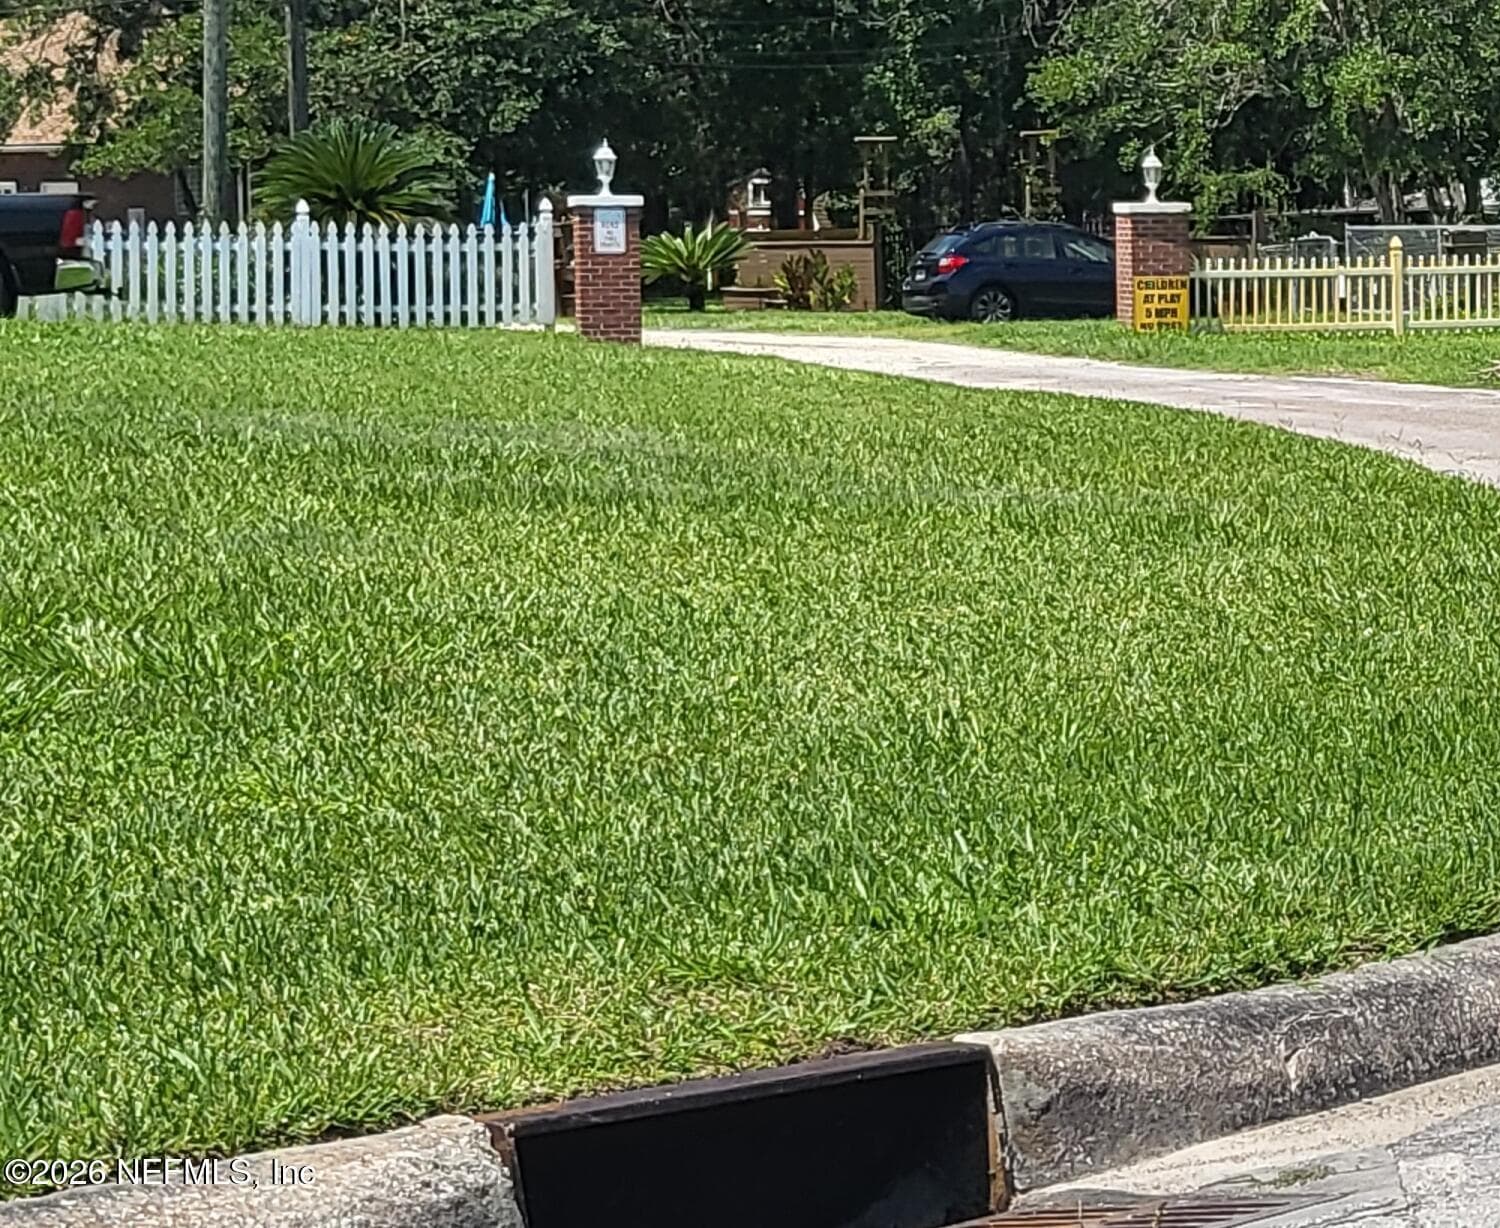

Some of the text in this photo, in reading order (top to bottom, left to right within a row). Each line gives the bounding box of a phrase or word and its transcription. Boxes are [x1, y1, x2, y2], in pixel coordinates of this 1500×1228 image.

[1137, 279, 1187, 291] CHILDREN
[1143, 293, 1182, 304] AT PLAY
[1155, 307, 1178, 318] MPH
